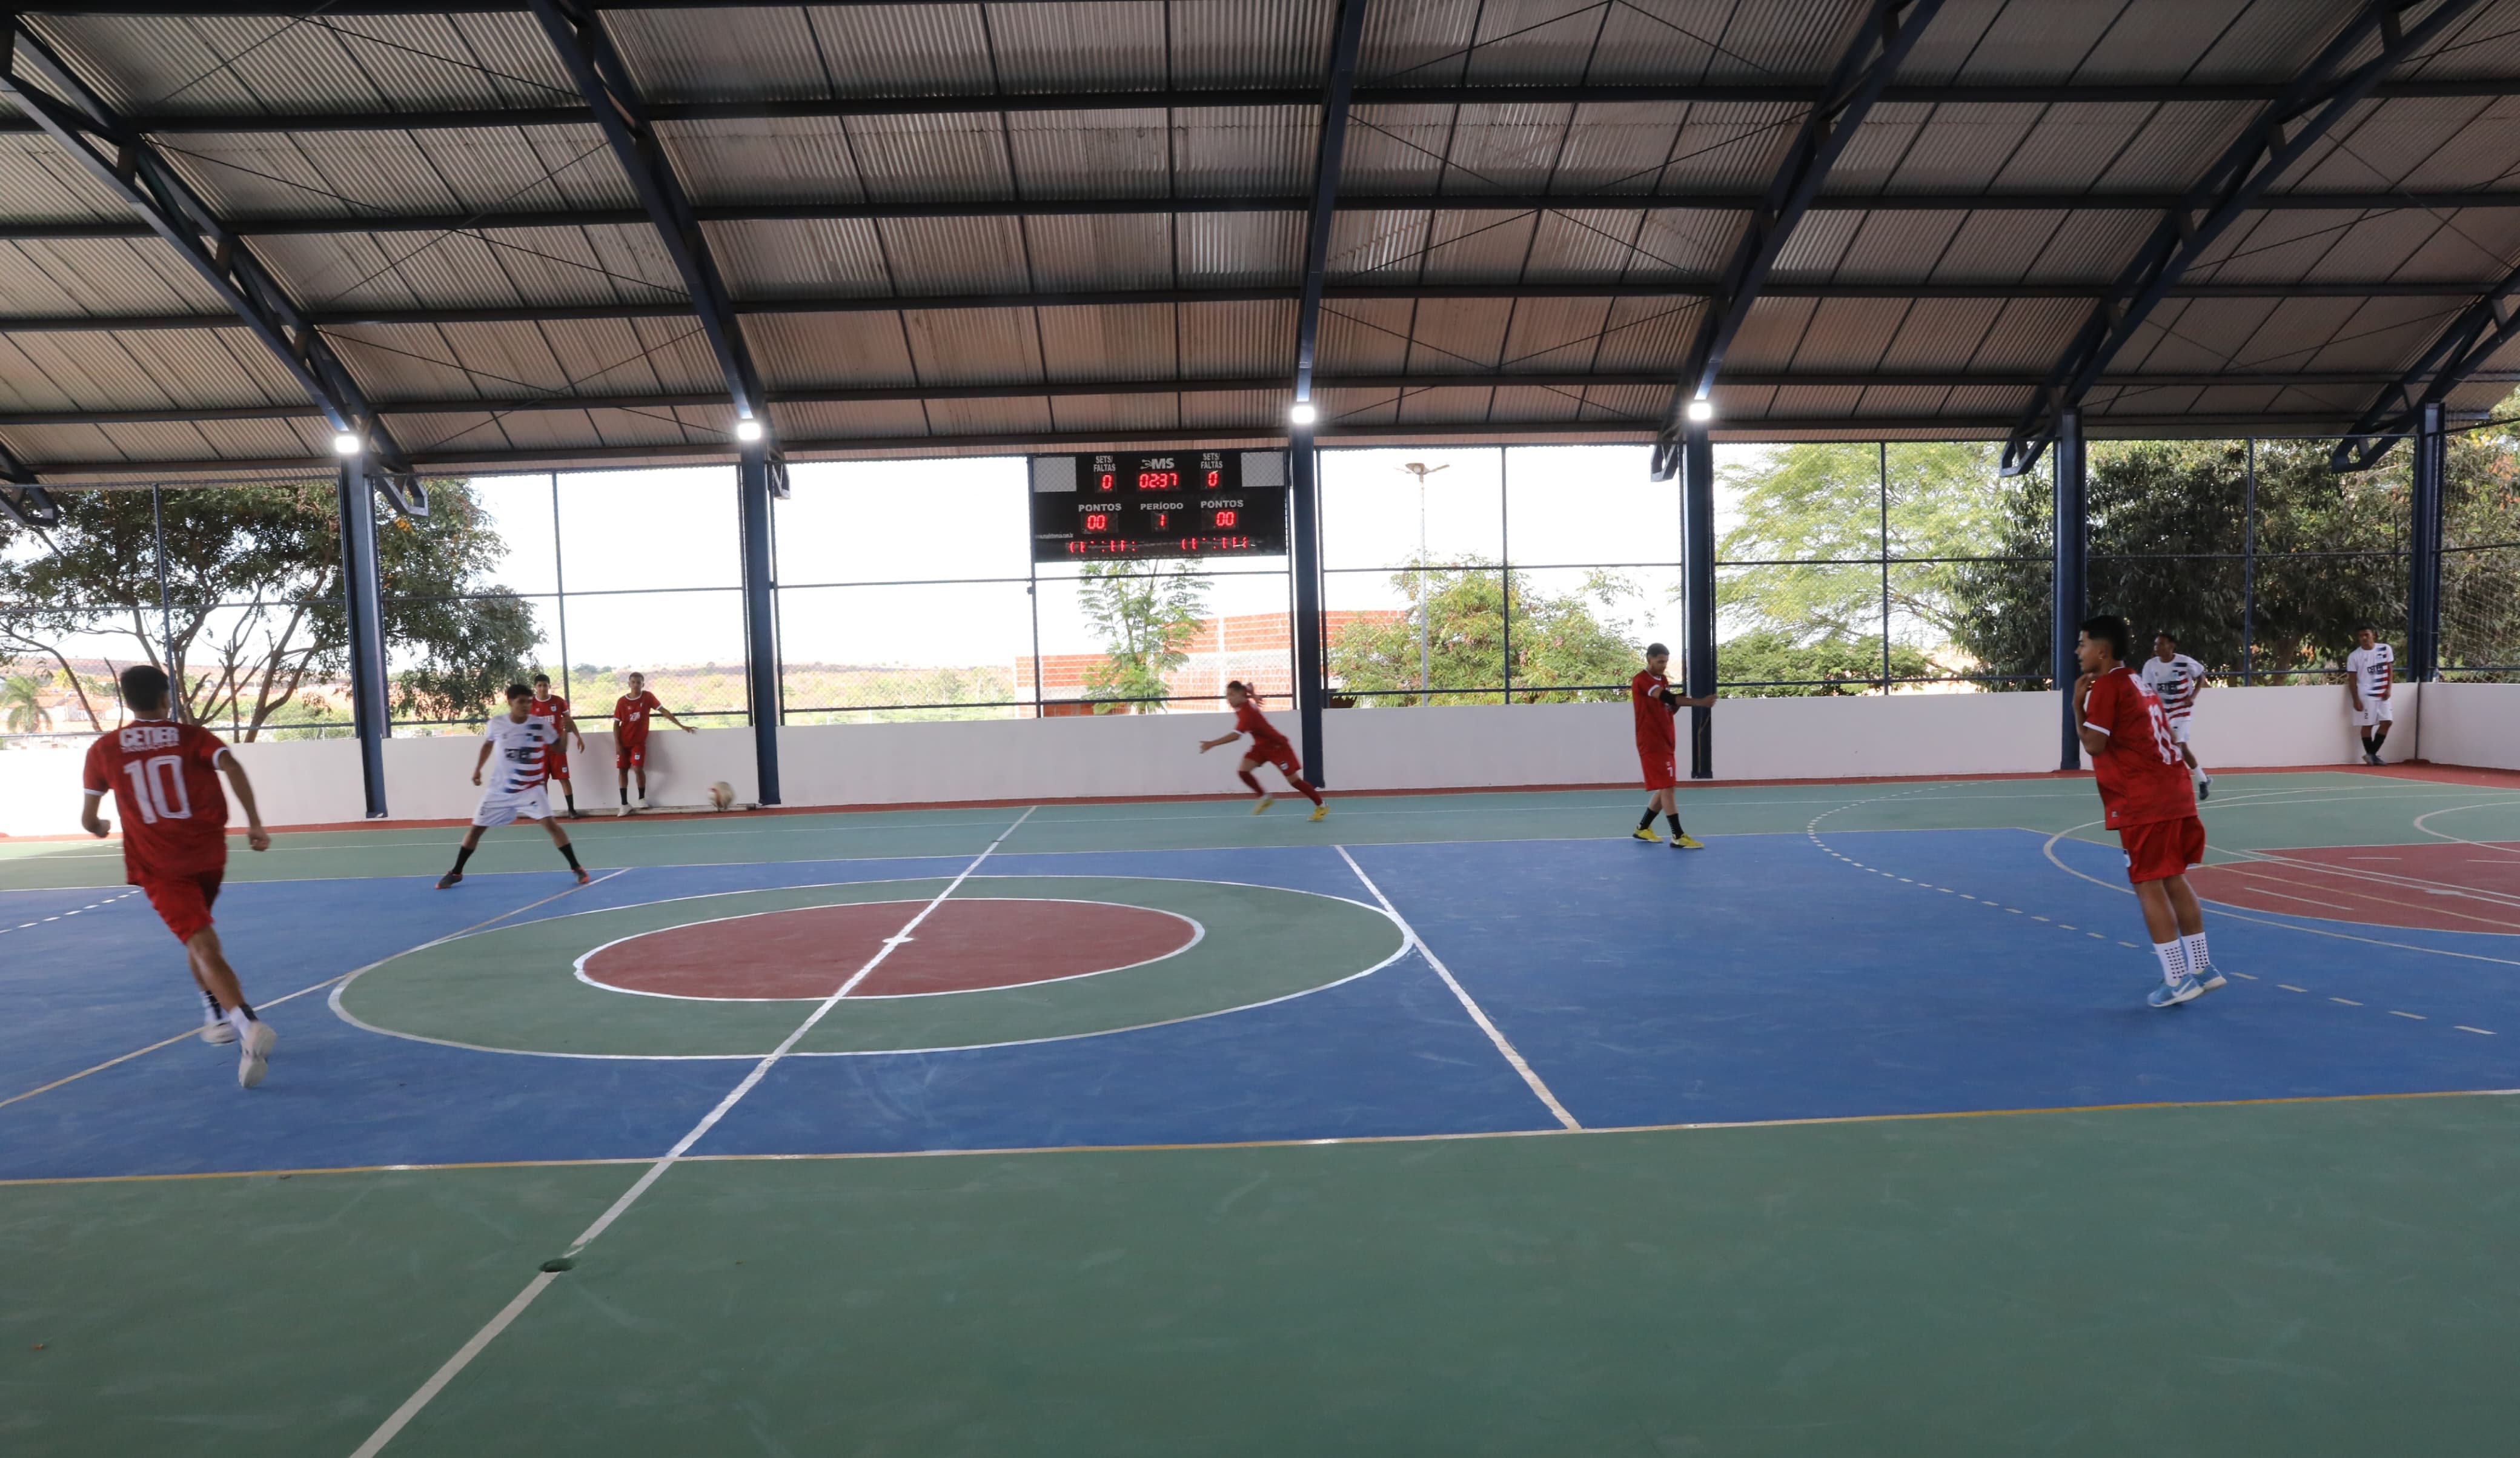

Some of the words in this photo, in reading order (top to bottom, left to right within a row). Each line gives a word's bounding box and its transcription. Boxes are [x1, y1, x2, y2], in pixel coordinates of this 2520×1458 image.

[1095, 455, 1113, 463] SETS/
[1151, 458, 1175, 469] MS
[1093, 463, 1116, 472] FALTAS
[1102, 474, 1112, 489] 0
[1139, 473, 1178, 488] 02:37
[1208, 472, 1218, 486] 0
[1078, 503, 1122, 512] PONTOS
[1140, 502, 1184, 510] PERÍODO
[1201, 500, 1244, 508] PONTOS
[1087, 515, 1106, 529] 00
[1159, 515, 1165, 526] 1
[1216, 511, 1235, 526] 00
[124, 755, 192, 824] 10
